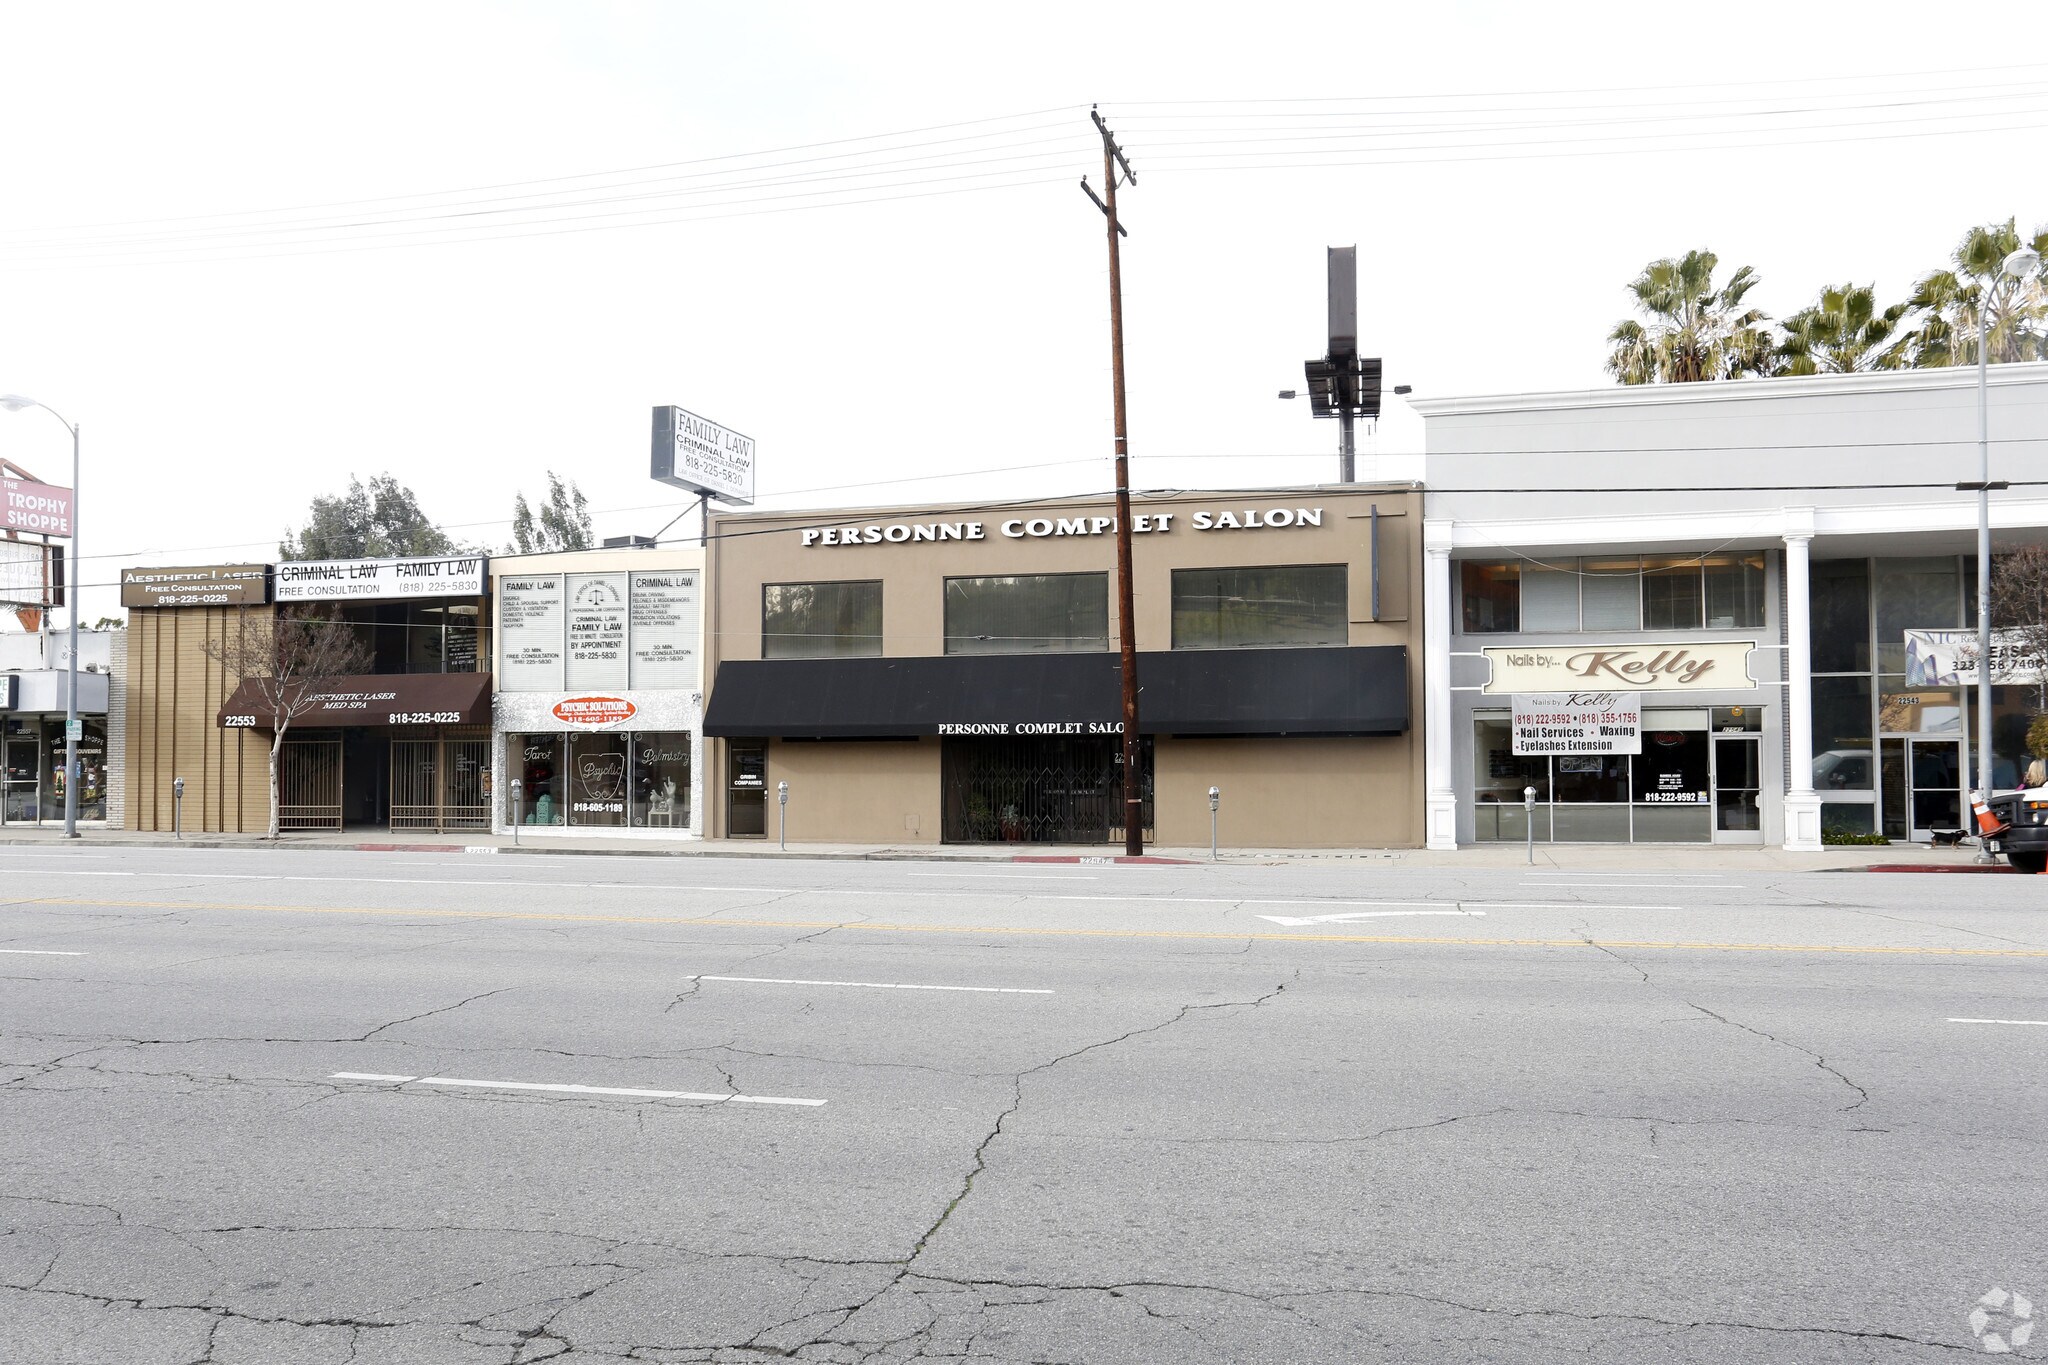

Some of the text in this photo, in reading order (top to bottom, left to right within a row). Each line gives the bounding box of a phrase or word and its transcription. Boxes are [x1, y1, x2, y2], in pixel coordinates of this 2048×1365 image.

[678, 414, 750, 457] FAMILY LAW
[676, 434, 750, 468] CRIMINAL LAW
[680, 444, 746, 474] FREE CONSULTATION
[686, 455, 742, 486] 818-225-5830
[4, 481, 18, 489] THE
[8, 492, 66, 514] TROPHY
[8, 511, 67, 531] SHOPPE
[801, 522, 985, 546] PERSONNE
[1192, 508, 1323, 530] SALON
[125, 572, 208, 582] AESTHETIC
[281, 560, 478, 582] CRIMINAL LAW FAMILY LAW
[279, 581, 478, 596] FREE CONSULTATION (818) 225-5830
[507, 582, 534, 590] FAMILY
[636, 577, 693, 588] CRIMINAL LAW
[158, 594, 228, 604] 818-225-0225
[1507, 650, 1715, 684] Nails by... Kelly
[561, 702, 628, 712] PSYCHIC SOLUTIONS
[1566, 693, 1617, 712] Kelly
[225, 712, 460, 726] 22553 818-225-0225
[1515, 713, 1637, 726] (818) 222-9592 (818) 355-1756
[938, 723, 1124, 734] PERSONNE COMPLET SALO
[1521, 726, 1635, 738] Nail Services Waxing
[523, 746, 552, 761] Tarot
[1521, 740, 1612, 752] Eyelashes Extension
[642, 748, 690, 766] Palmistry
[583, 762, 621, 781] Psychic
[1645, 793, 1696, 801] 818-222-9592
[574, 803, 623, 812] 818-605-1189
